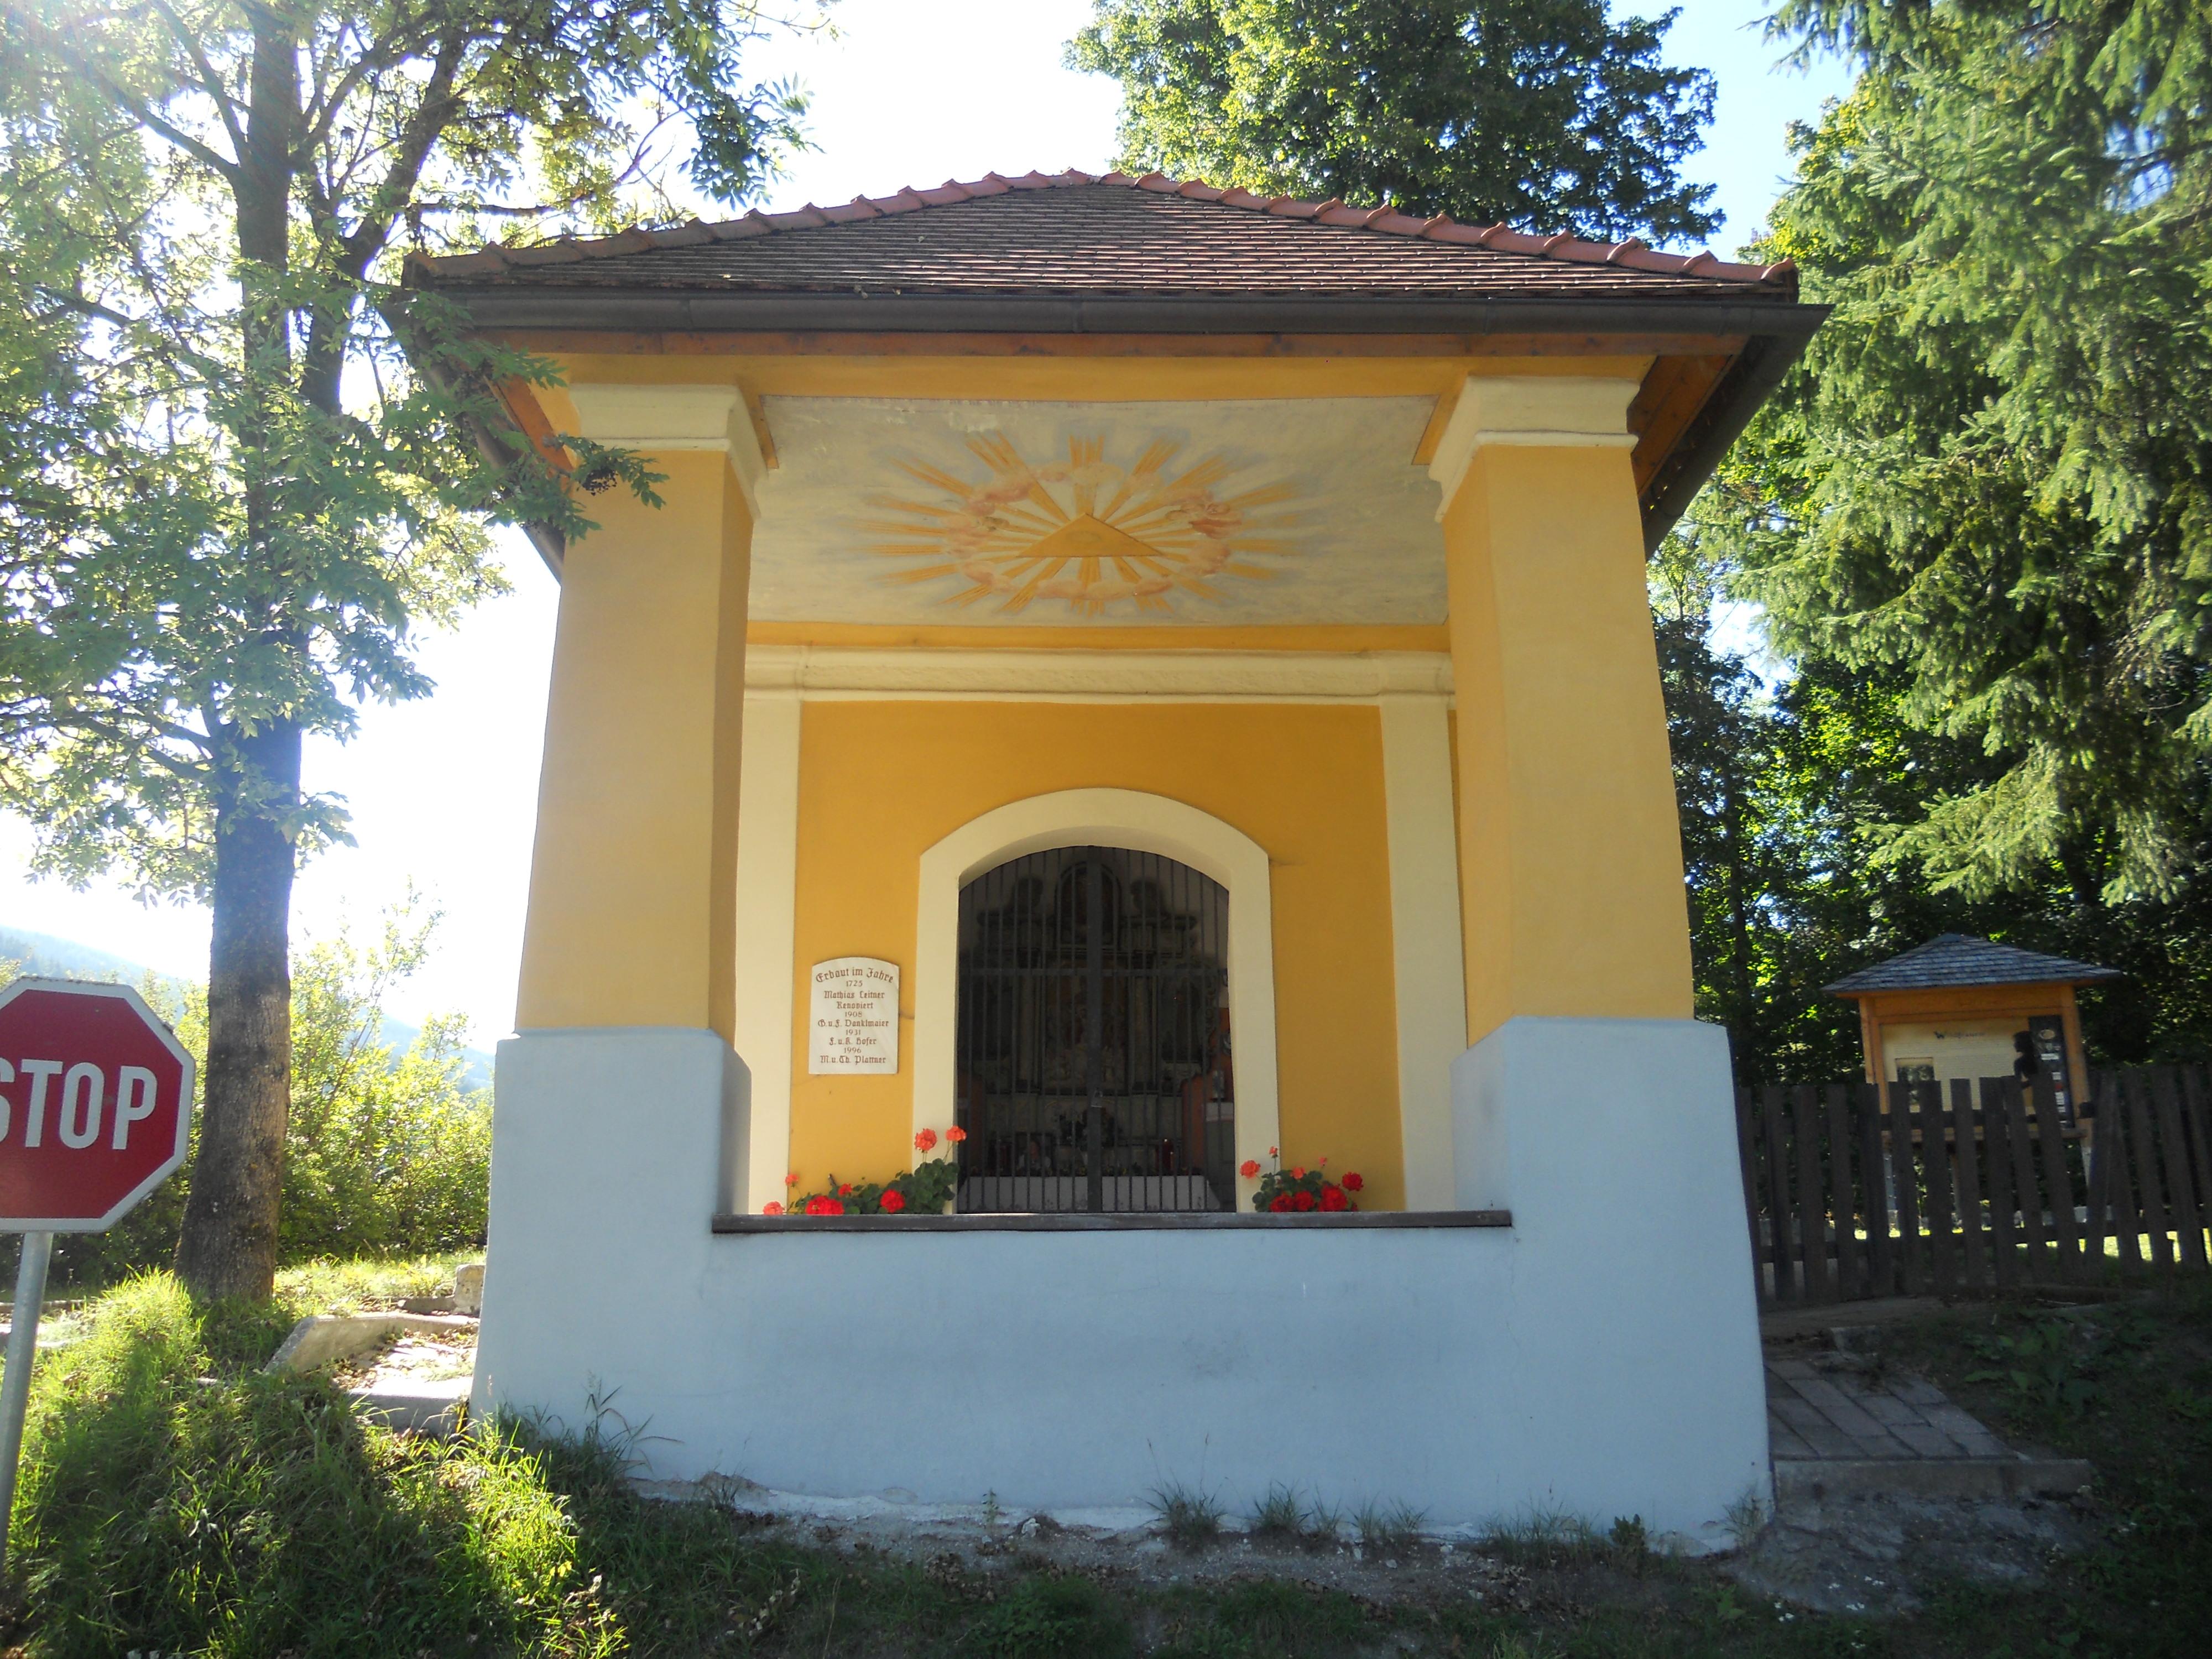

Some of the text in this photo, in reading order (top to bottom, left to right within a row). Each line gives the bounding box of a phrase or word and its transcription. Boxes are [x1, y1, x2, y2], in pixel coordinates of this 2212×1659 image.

[816, 967, 894, 983] Erbaut im Jahre
[824, 990, 885, 999] Mathias Leitner
